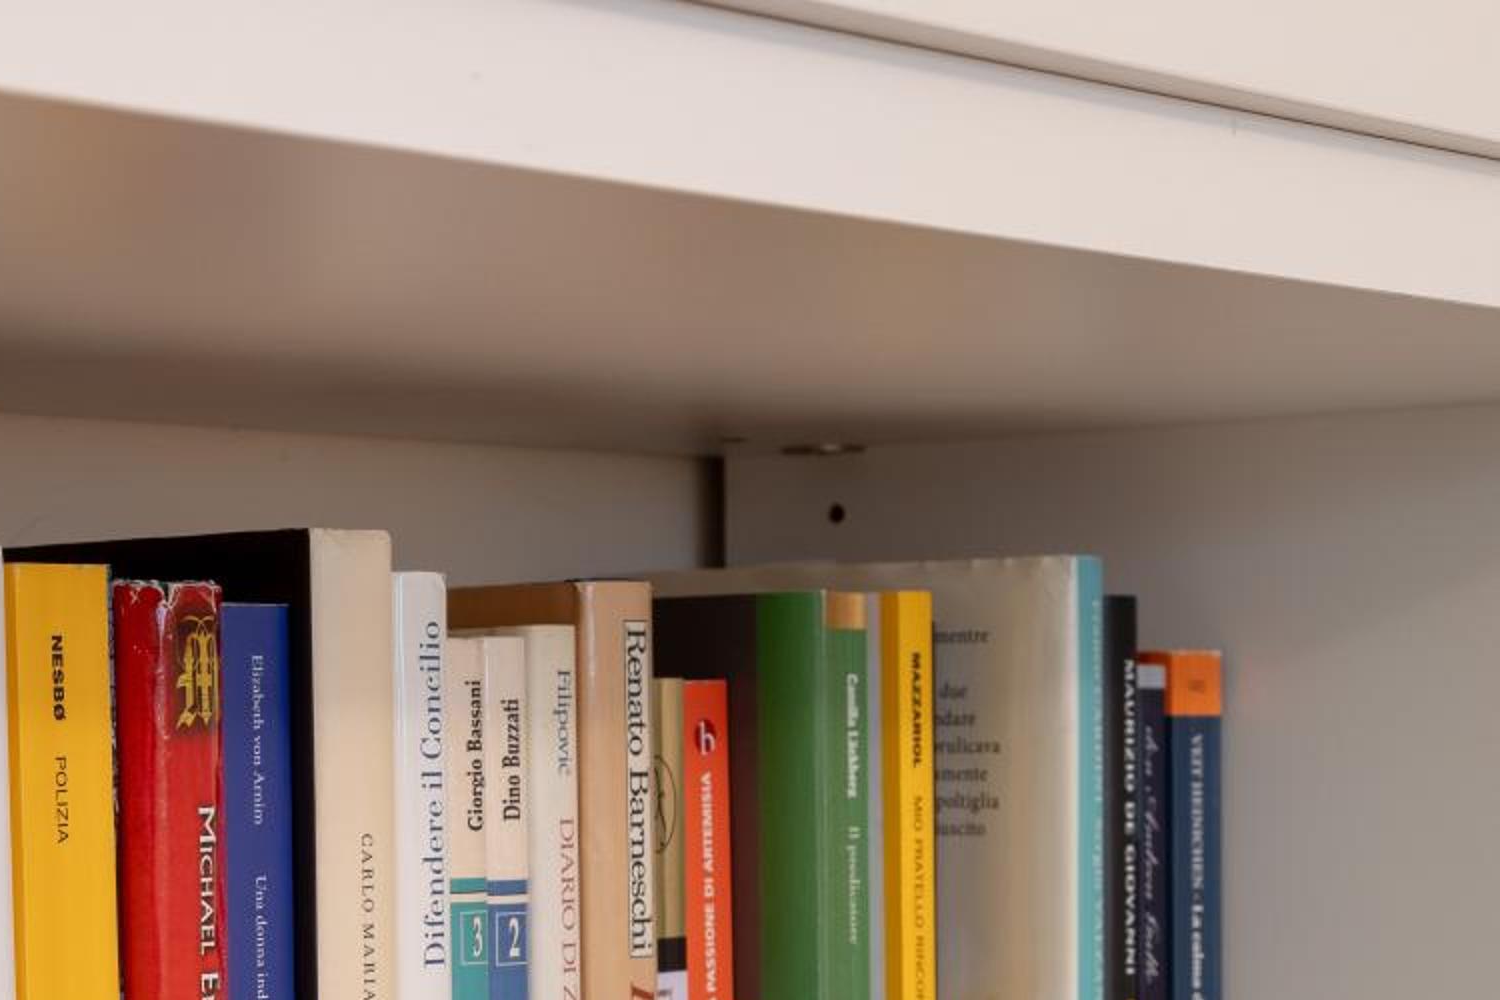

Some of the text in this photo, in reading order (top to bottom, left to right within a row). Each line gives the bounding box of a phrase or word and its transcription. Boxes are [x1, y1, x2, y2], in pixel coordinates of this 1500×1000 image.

[250, 654, 267, 730] Elizabeth
[911, 652, 923, 769] MAZZARIOL
[1123, 658, 1136, 793] MAURIZIO
[50, 633, 70, 845] NESBØ POLIZIA
[253, 731, 264, 760] von
[465, 680, 485, 832] Giorgio Bassani
[501, 698, 521, 822] Dino Buzzati
[252, 768, 267, 827] Arnim
[419, 621, 446, 968] Difendere il Concilio
[627, 629, 653, 950] Renato Barneschi
[701, 771, 716, 873] ARTEMISIA
[1124, 800, 1136, 834] DE
[197, 806, 218, 955] MICHAEL
[254, 874, 268, 910] Una
[360, 832, 376, 914] CARLO
[559, 818, 576, 932] DIARIO
[703, 876, 716, 897] DI
[914, 838, 926, 929] FRATELLO
[1124, 843, 1137, 976] GIOVANNI
[1190, 903, 1204, 929] La
[255, 911, 268, 968] donna
[472, 915, 483, 958] 3
[508, 916, 520, 958] 2
[562, 942, 577, 974] DI
[703, 903, 718, 993] PASSIONE
